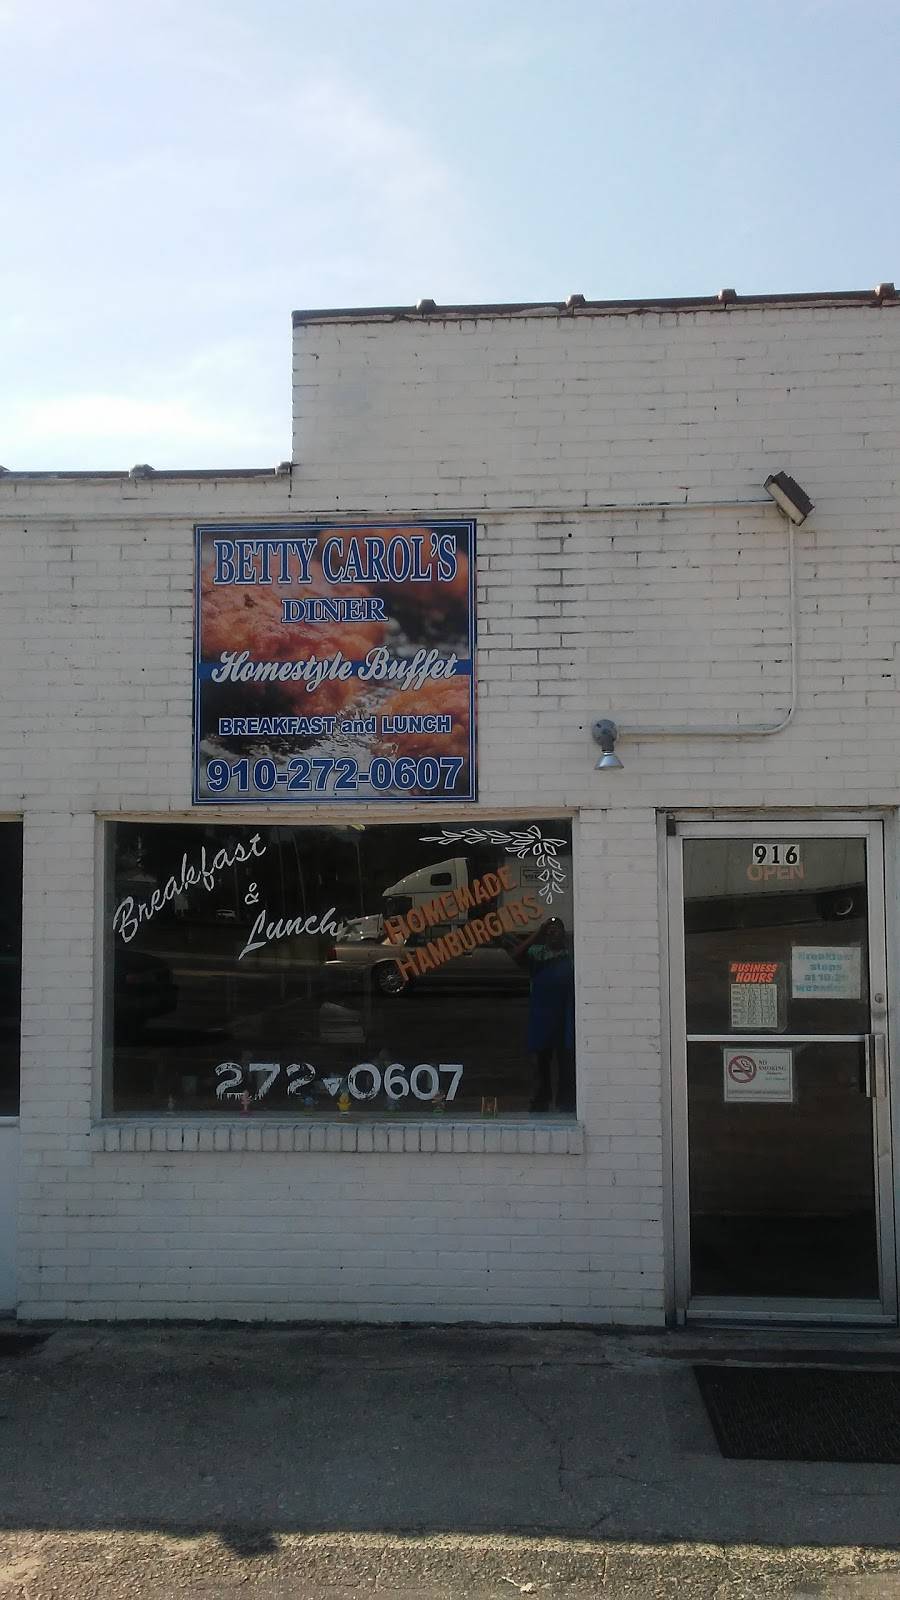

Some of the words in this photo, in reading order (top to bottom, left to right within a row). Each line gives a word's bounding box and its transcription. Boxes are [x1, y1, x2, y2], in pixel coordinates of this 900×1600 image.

[213, 538, 317, 585] BETTY
[322, 534, 457, 583] CAROL'S
[281, 597, 388, 623] DINER
[211, 650, 353, 692] Homestyle
[358, 646, 458, 690] Buffet
[218, 717, 336, 735] BREAKFAST
[341, 717, 376, 734] and
[381, 715, 452, 733] LUNCH
[206, 757, 464, 791] 910-272-0607
[754, 845, 798, 864] 916
[746, 864, 806, 881] OPEN
[112, 833, 267, 943] Breakfast
[244, 882, 259, 905] &
[384, 864, 518, 944] HOMEMADE
[238, 907, 342, 961] Lunch
[395, 895, 544, 981] HAMBURGERS
[730, 963, 778, 973] BUSINESS
[735, 972, 774, 983] HOURS
